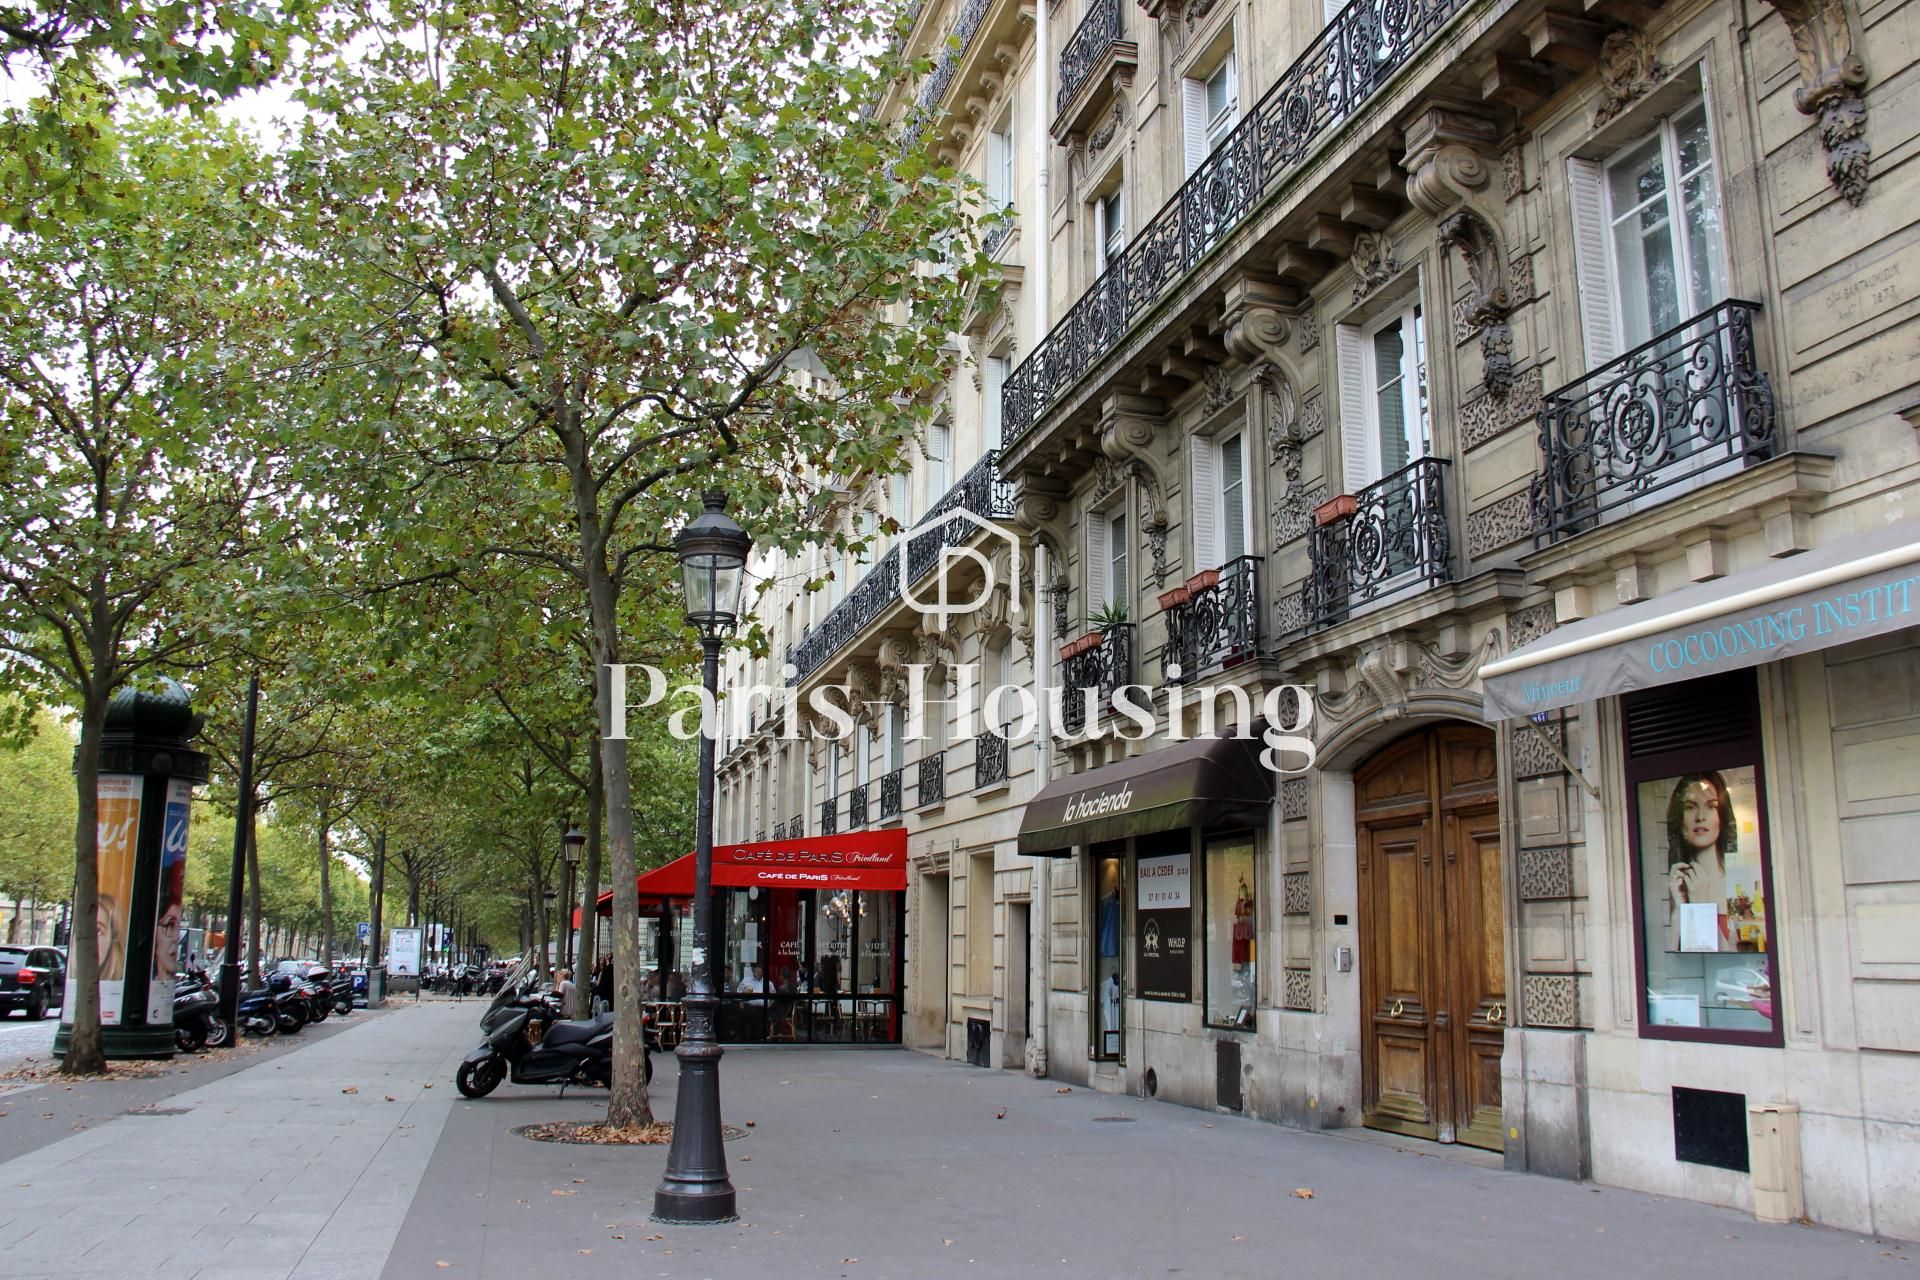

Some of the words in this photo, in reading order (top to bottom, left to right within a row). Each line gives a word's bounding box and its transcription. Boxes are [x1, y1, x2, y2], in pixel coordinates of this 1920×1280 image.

[1650, 608, 1808, 673] COCOONING
[1812, 576, 1920, 637] INSTIT
[1521, 676, 1582, 704] Minceur
[1062, 796, 1076, 822] la
[1074, 781, 1133, 819] hacienda
[733, 849, 773, 862] CAFÉ
[775, 852, 796, 862] DE
[799, 850, 844, 863] PARIS
[845, 851, 893, 863] Friedland
[799, 873, 828, 881] PARIS
[353, 976, 363, 987] P
